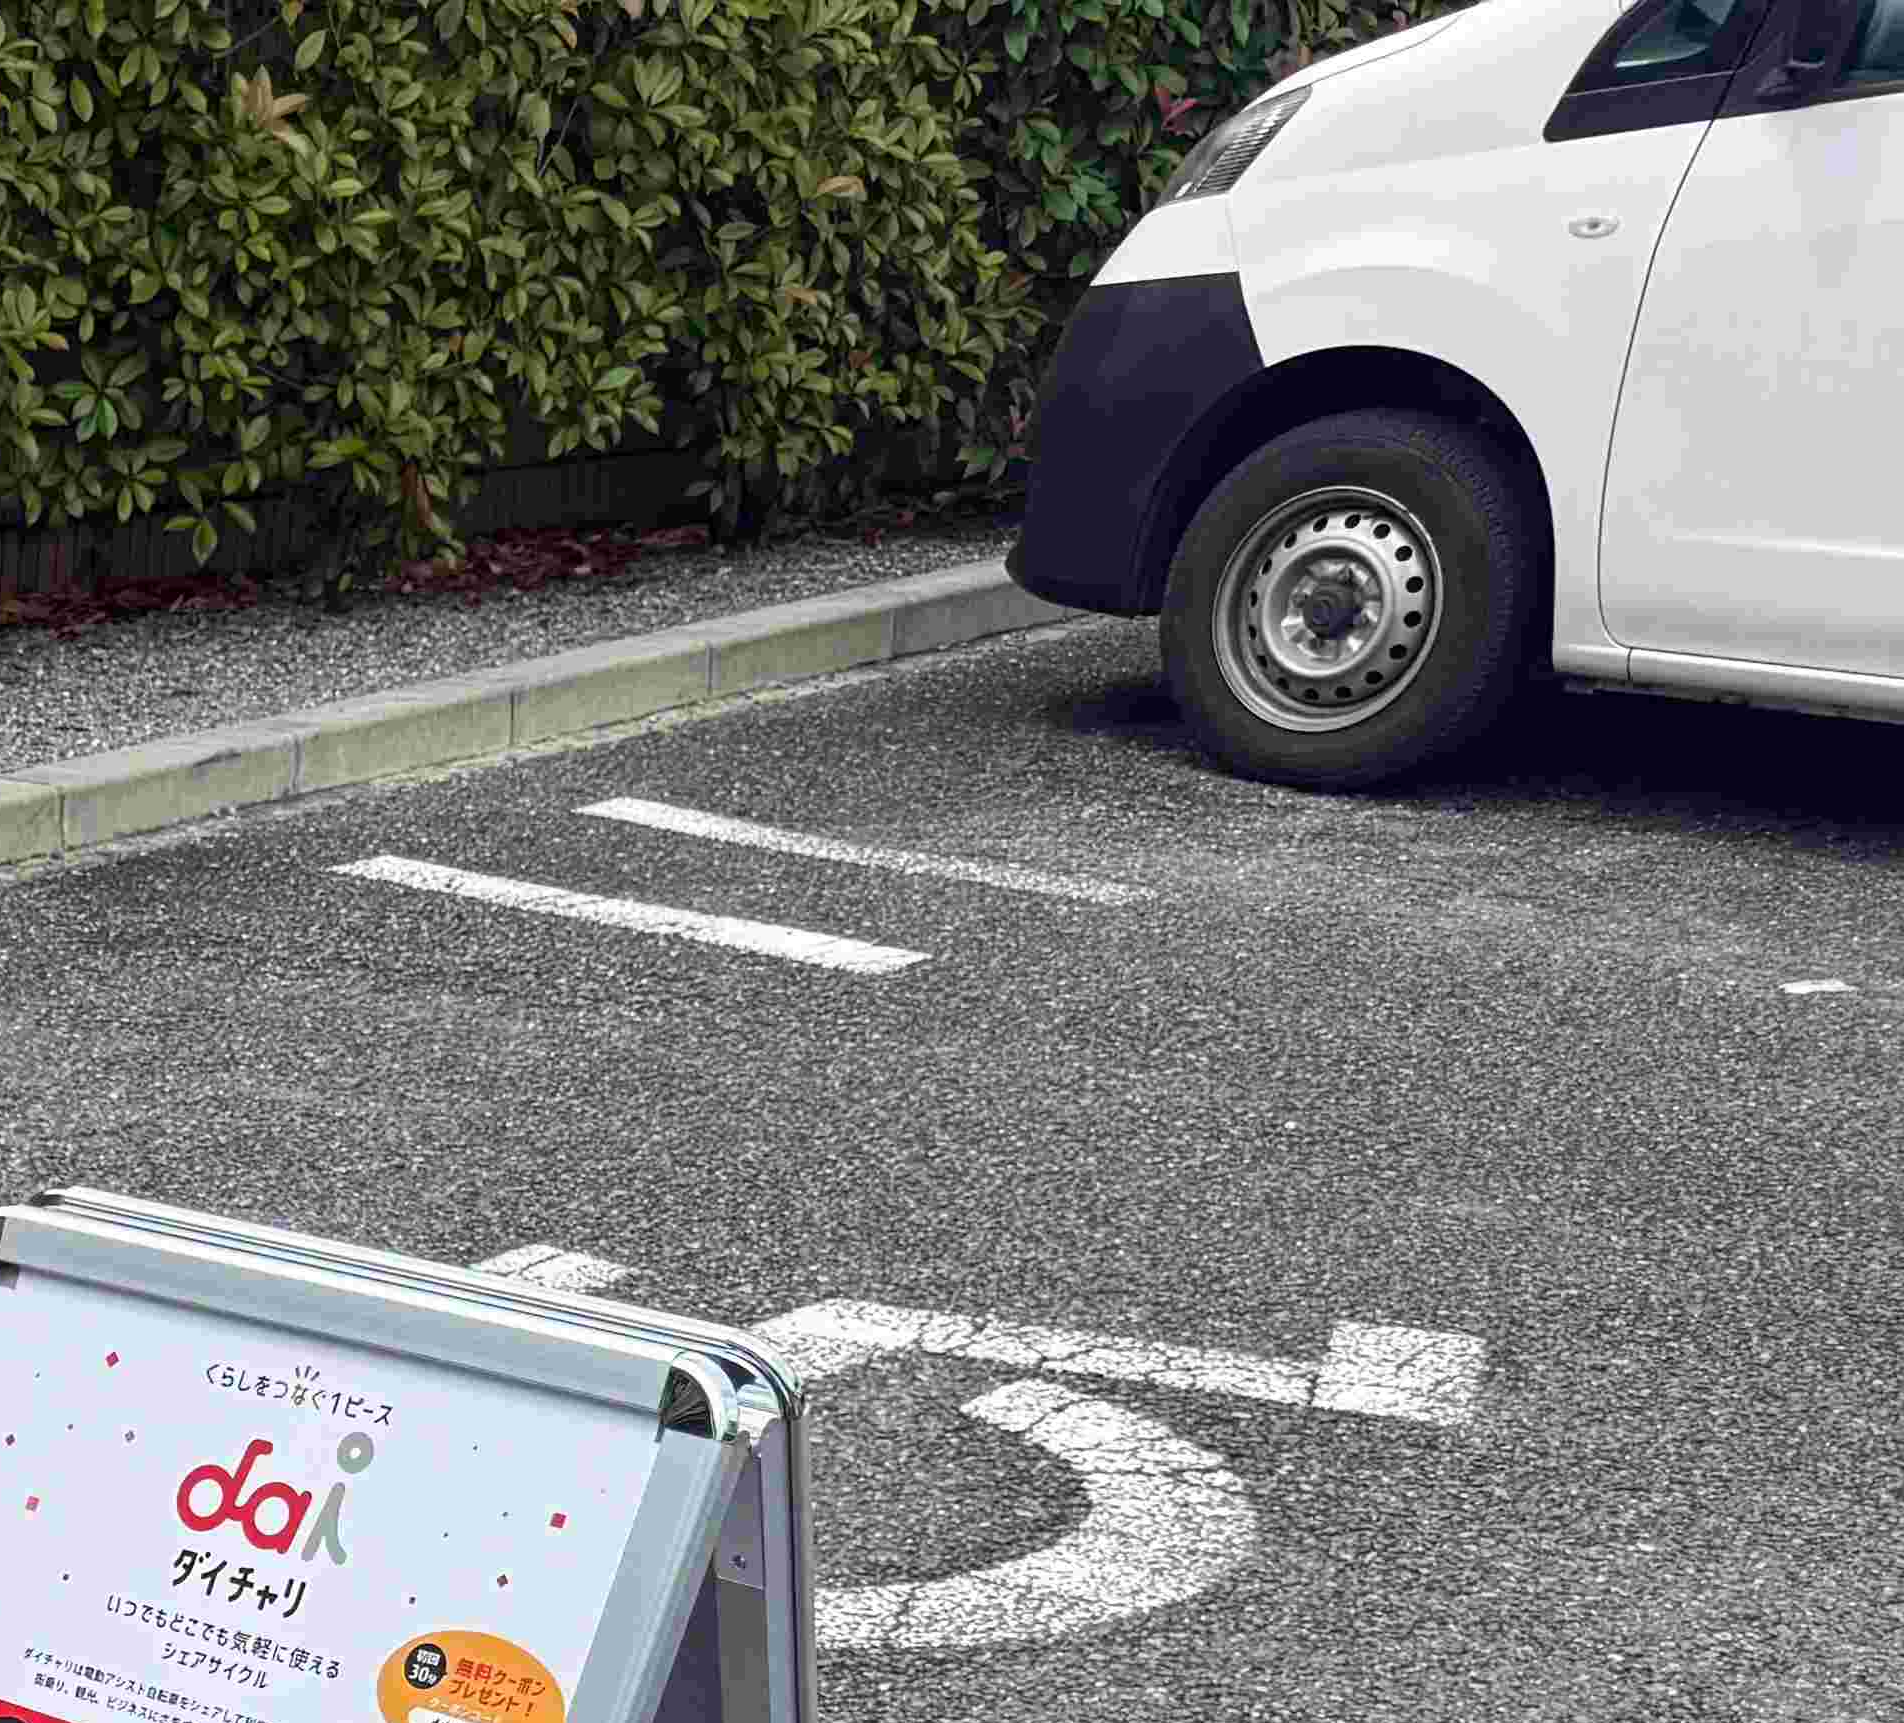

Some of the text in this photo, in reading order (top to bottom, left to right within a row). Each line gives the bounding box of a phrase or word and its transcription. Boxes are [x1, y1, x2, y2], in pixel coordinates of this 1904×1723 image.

[205, 1363, 394, 1426] くらしをつなぐ1ピース
[176, 1431, 375, 1566] dai
[172, 1549, 307, 1618] ダイチャリ
[106, 1594, 343, 1681] いつでもどこでも気軽に使える
[160, 1642, 270, 1690] シェアサイクル
[454, 1657, 546, 1696] 無料クーポン
